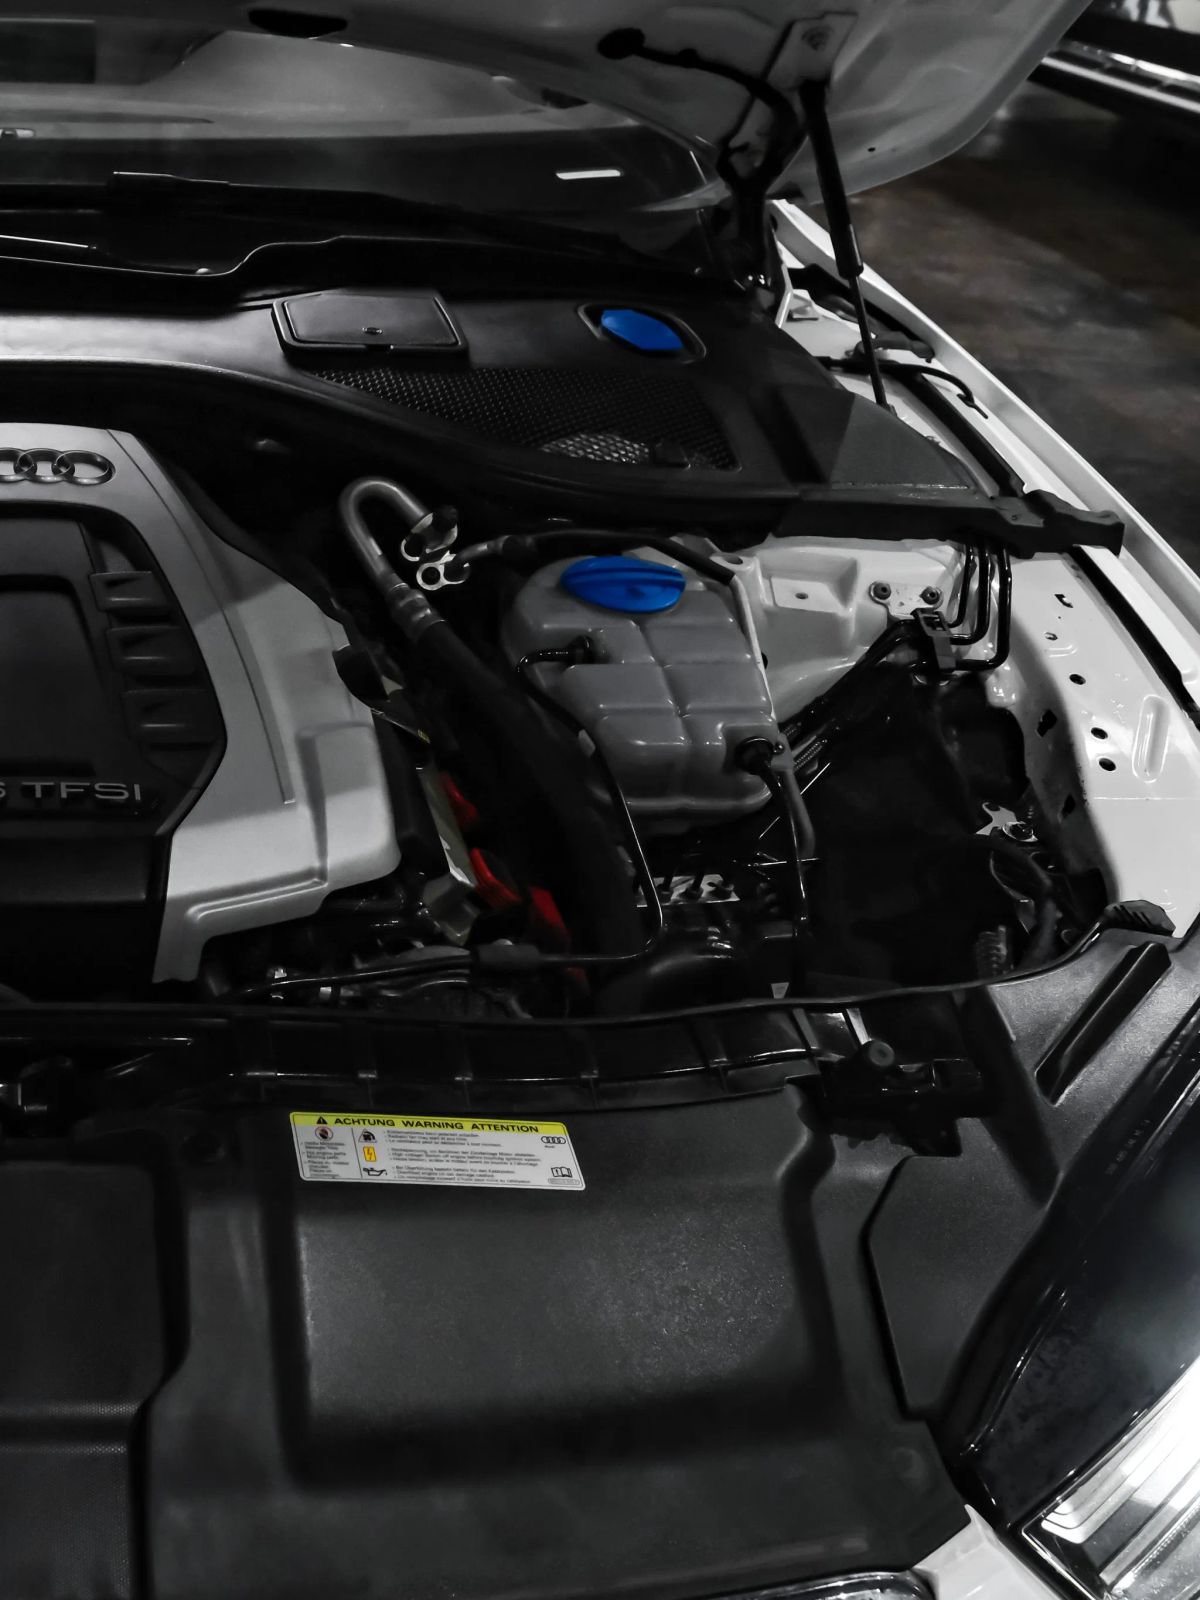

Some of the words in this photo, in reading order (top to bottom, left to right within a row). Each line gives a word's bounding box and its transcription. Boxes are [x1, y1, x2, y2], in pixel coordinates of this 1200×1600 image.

[21, 781, 141, 801] TFSI
[334, 1117, 396, 1127] ACHTUNG
[401, 1120, 464, 1130] WARNING
[471, 1123, 539, 1133] ATTENTION
